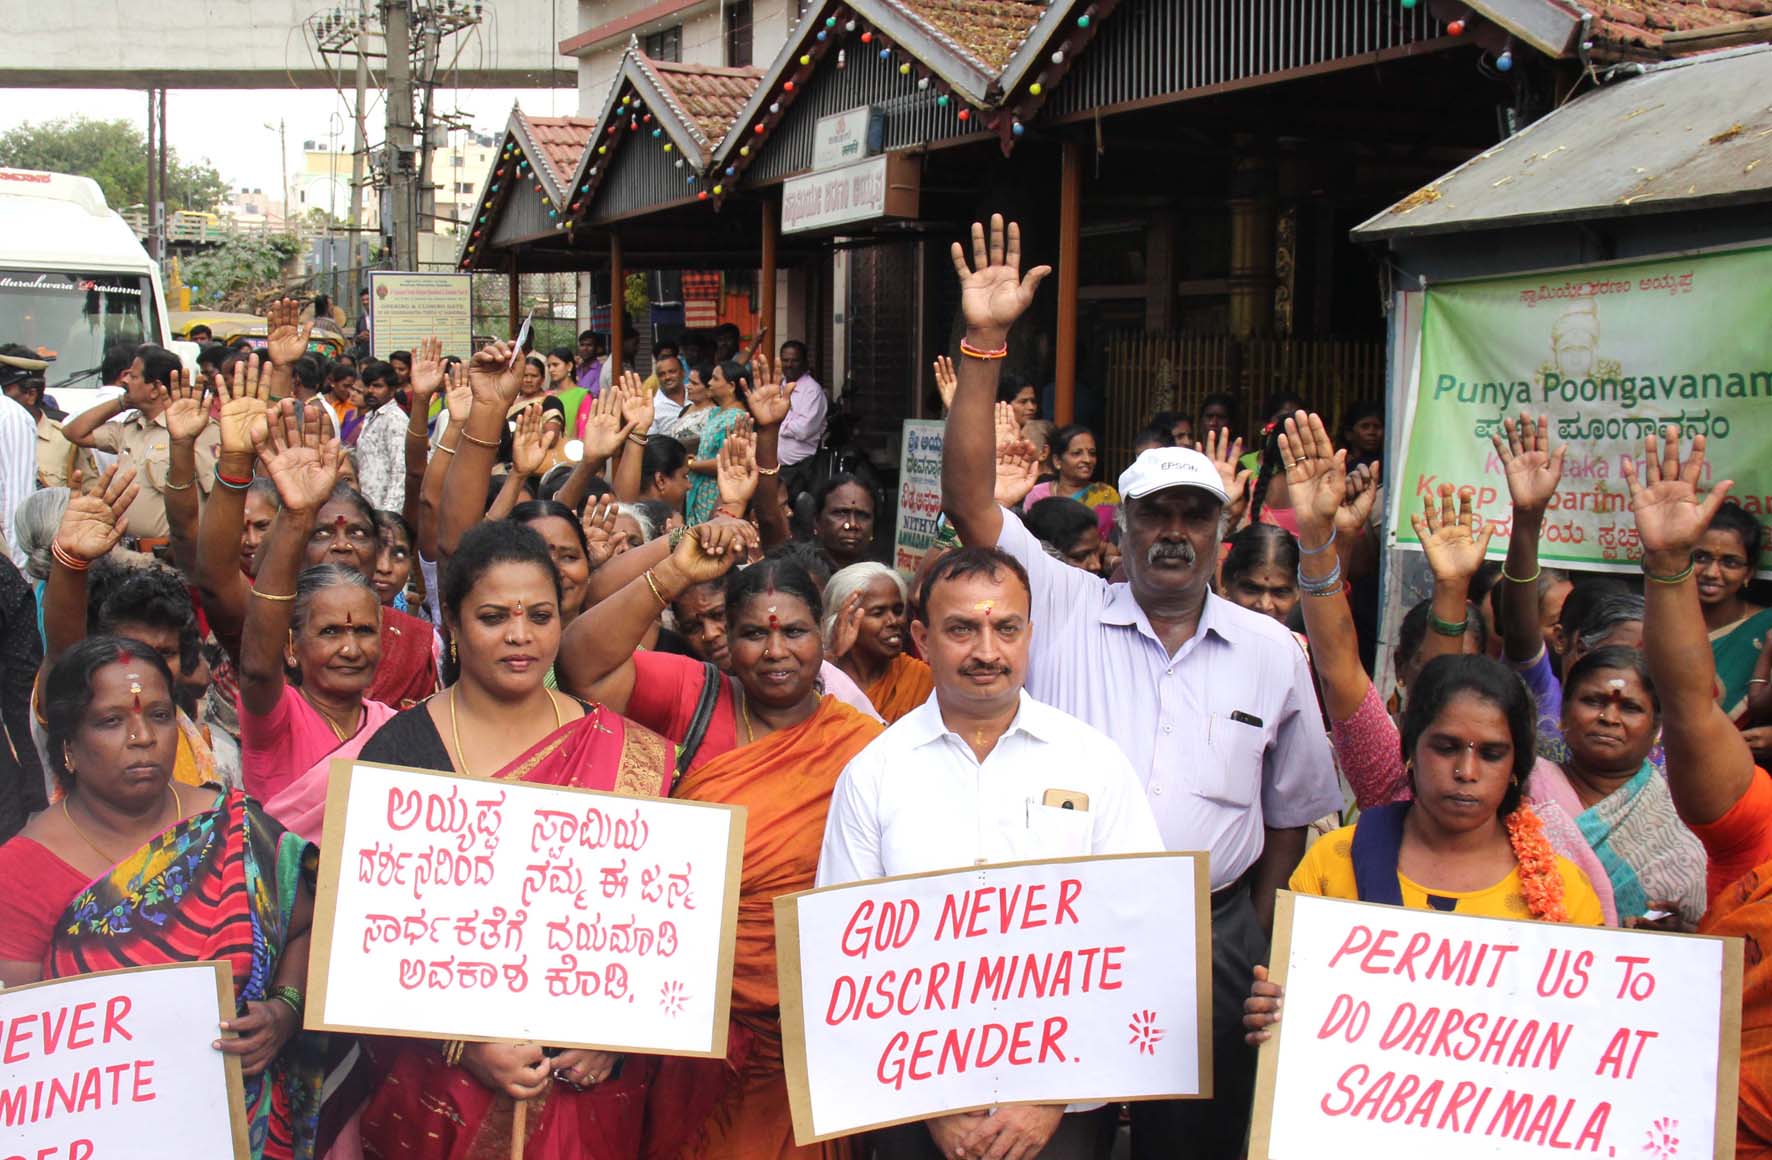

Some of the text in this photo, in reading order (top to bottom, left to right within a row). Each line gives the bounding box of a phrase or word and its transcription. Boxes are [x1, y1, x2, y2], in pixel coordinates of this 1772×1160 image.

[1639, 270, 1694, 296] ಅಯ್ಯಪ್ಪ
[1434, 370, 1772, 409] Punya Poongavanam
[1161, 462, 1198, 472] EPSON
[1415, 473, 1498, 509] Keep
[387, 784, 649, 860] ಅಯ್ಯಪ್ಪ ಸ್ವಾಮಿಯ
[358, 841, 495, 900] ದರ್ಶನದಿಂದ
[521, 859, 588, 911] ನಮ್ಮ
[598, 858, 629, 900] ಈ
[841, 879, 1083, 960] GOD NEVER
[399, 954, 529, 993] ಅವಕಾಶ
[826, 946, 1127, 1027] DISCRIMINATE
[1328, 924, 1519, 989] PERMIT
[1537, 948, 1594, 1000] US
[0, 995, 134, 1065] EVER
[877, 1016, 1081, 1091] GENDER.
[1317, 994, 1660, 1080] DO DARSHAN AT
